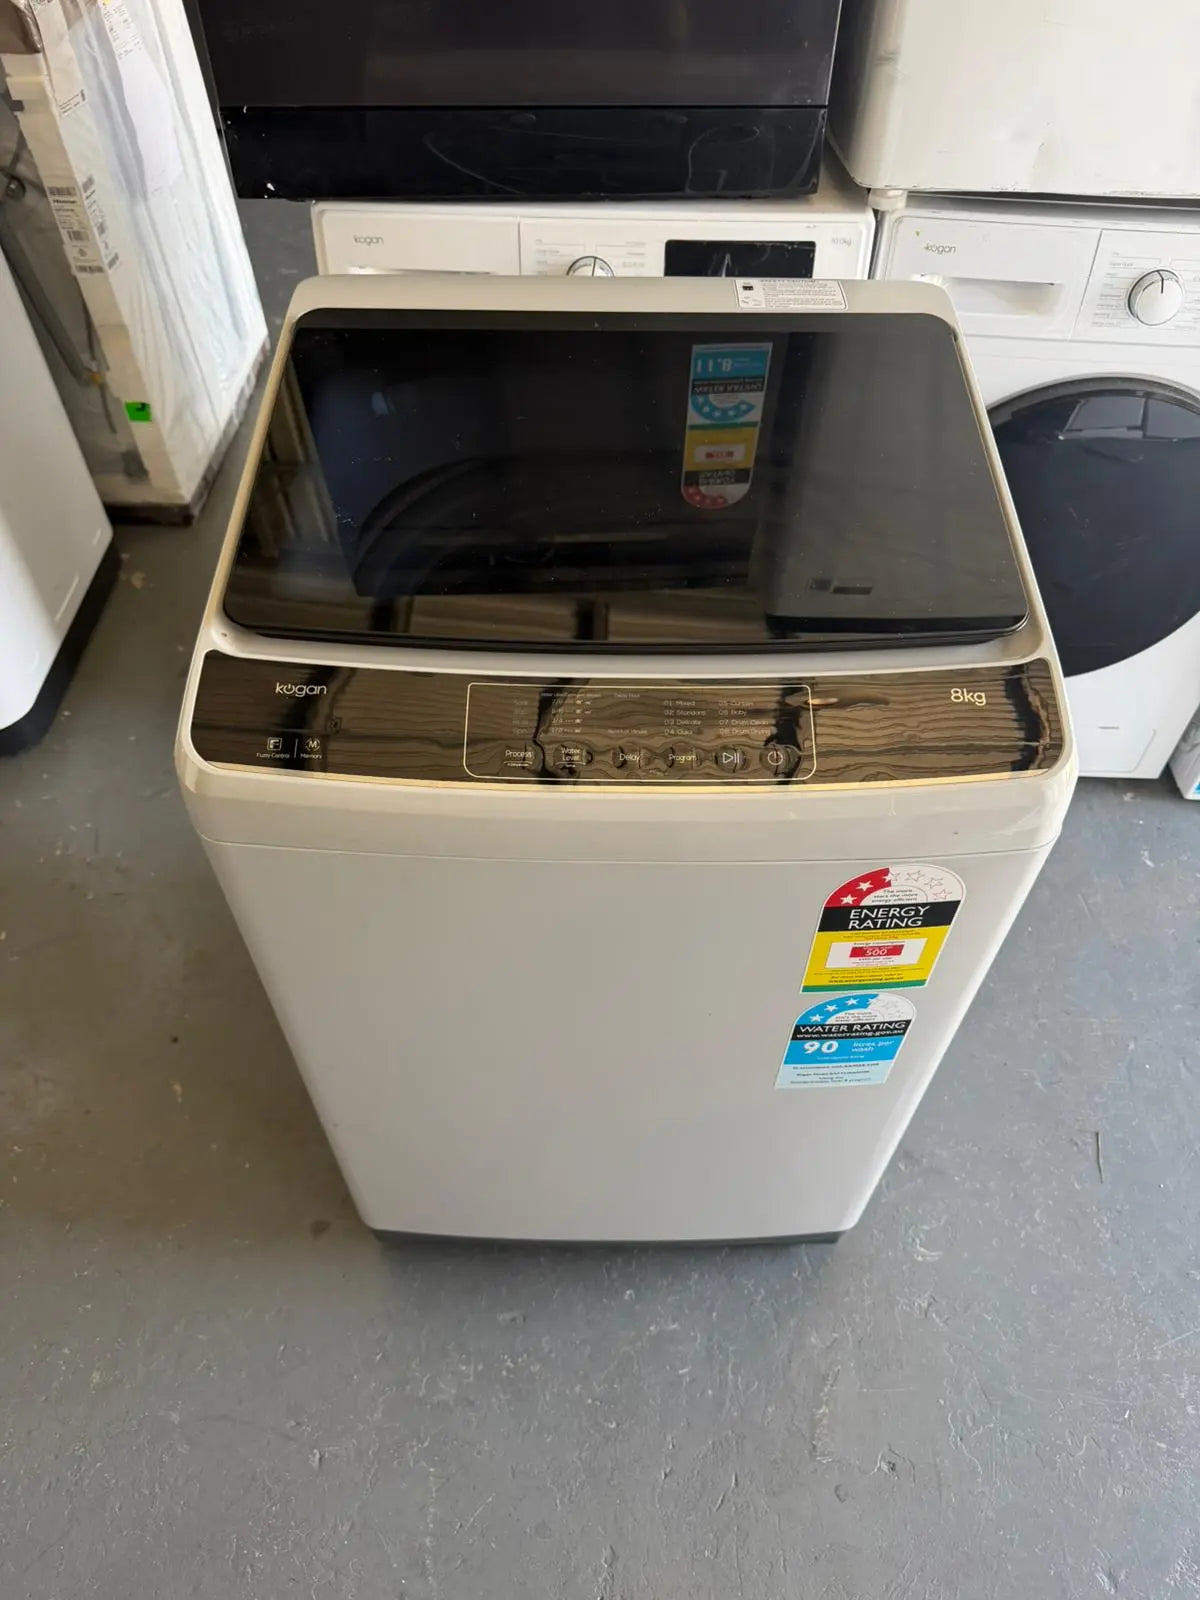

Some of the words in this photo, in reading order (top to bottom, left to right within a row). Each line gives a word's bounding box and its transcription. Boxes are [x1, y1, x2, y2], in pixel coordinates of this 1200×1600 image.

[353, 234, 384, 246] kogan
[275, 682, 327, 698] kogan
[950, 688, 986, 706] 8kg
[505, 749, 532, 759] Process
[561, 747, 581, 755] Water
[619, 753, 641, 763] Delay
[668, 754, 697, 764] Program
[849, 905, 930, 919] ENERGY
[848, 917, 923, 930] RATING
[865, 948, 888, 956] 500
[800, 1025, 848, 1033] WATER
[852, 1021, 906, 1031] RATING
[796, 1029, 904, 1039] www.waterrating.gov.au
[803, 1040, 839, 1054] 90
